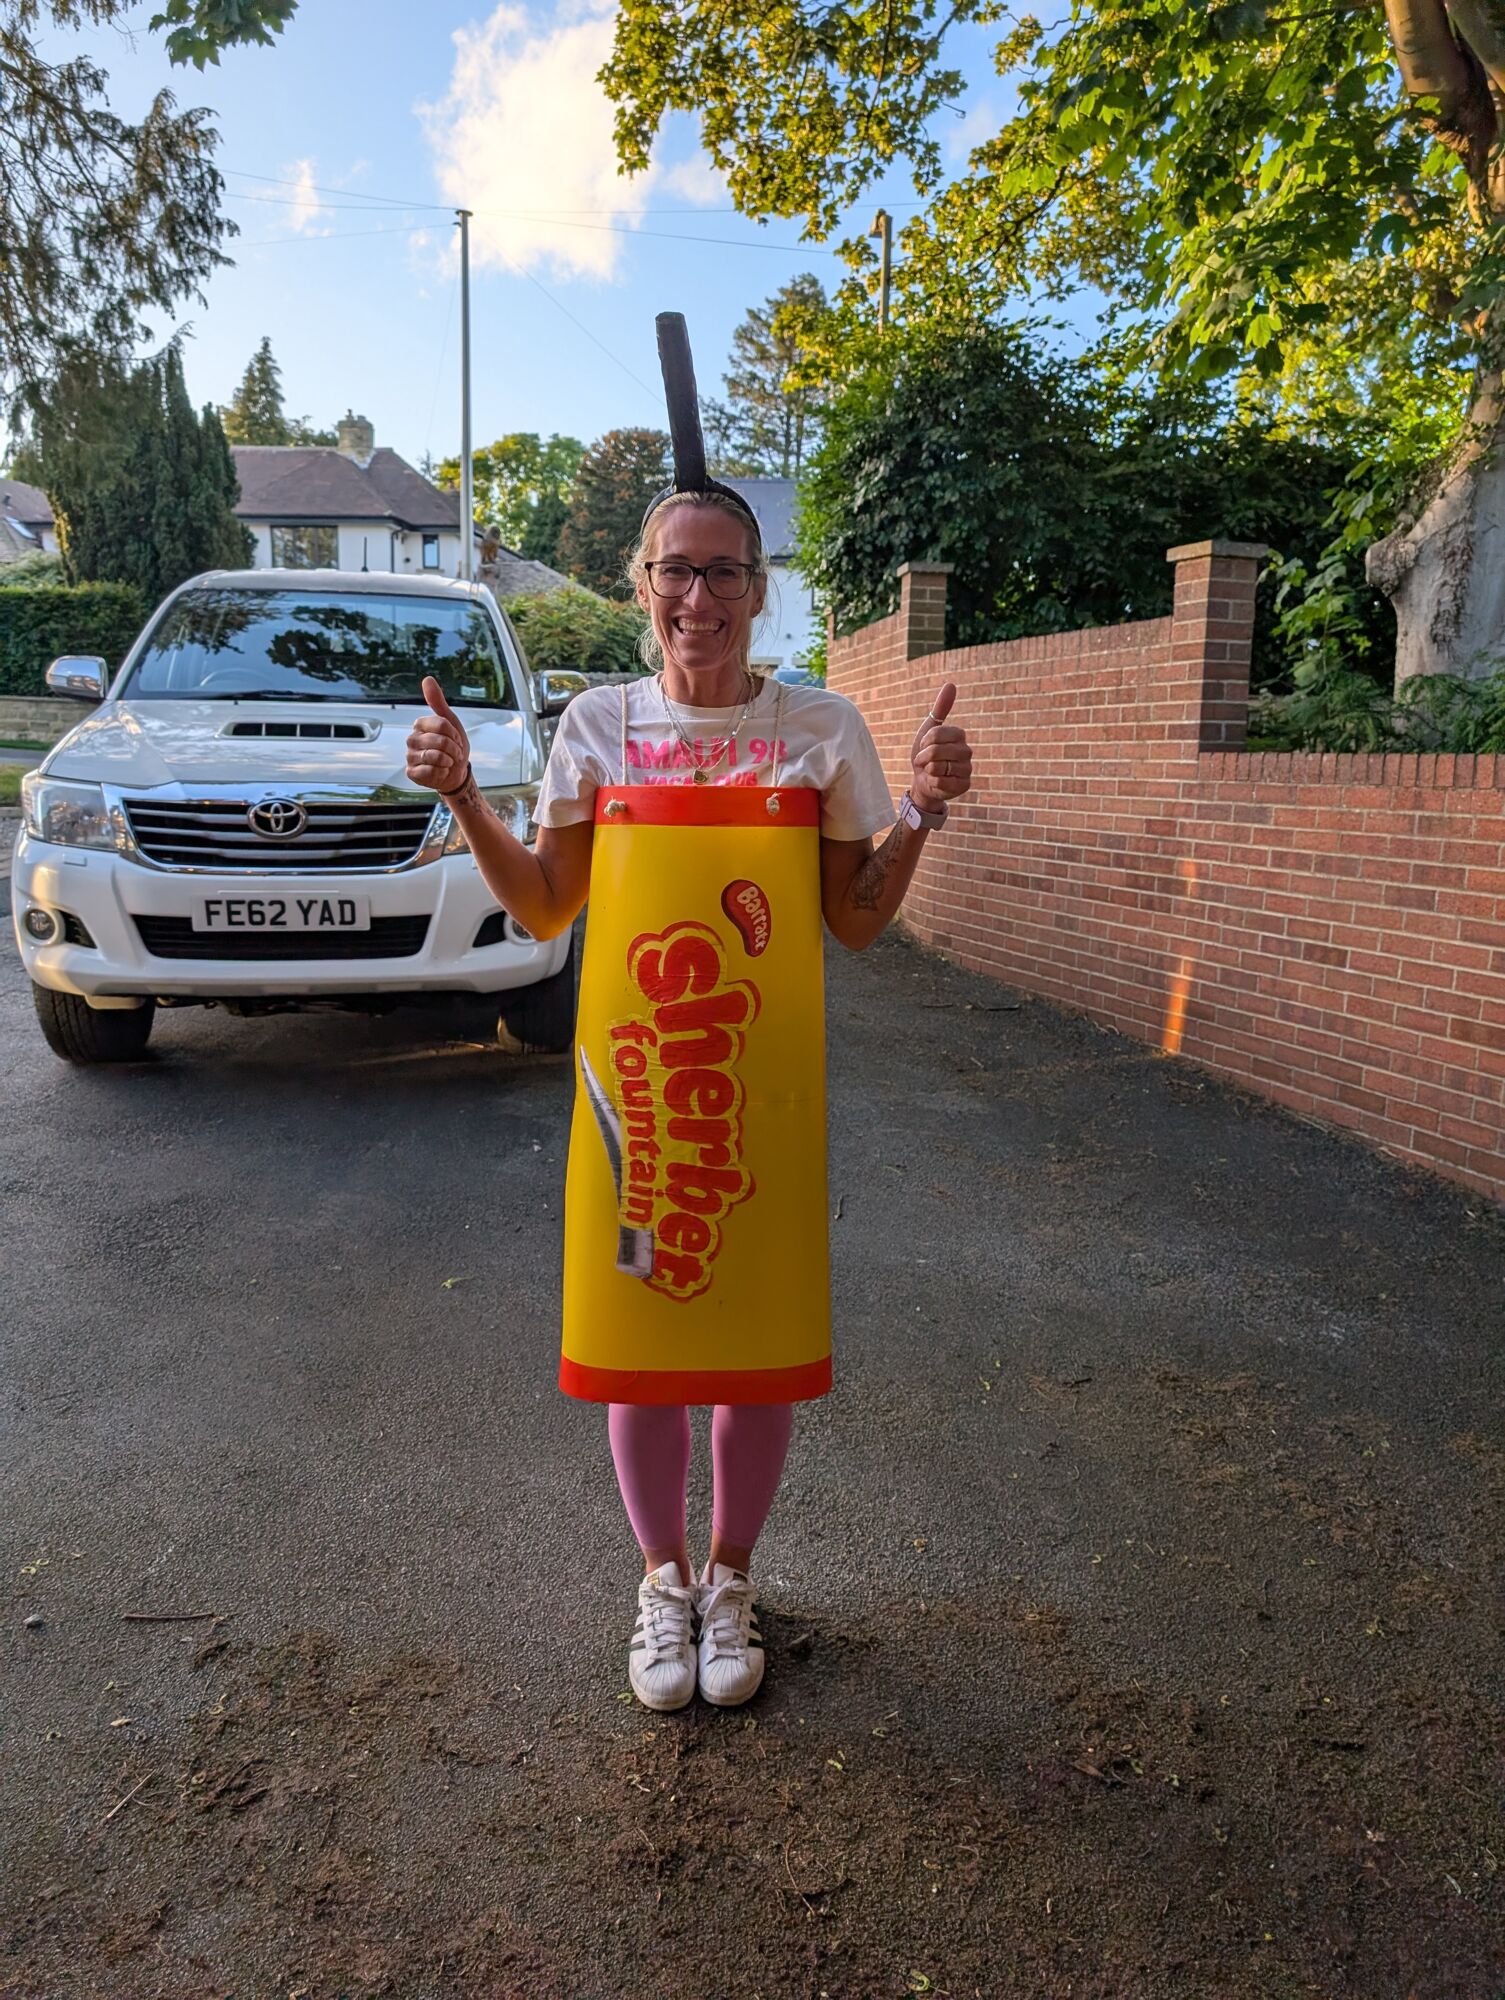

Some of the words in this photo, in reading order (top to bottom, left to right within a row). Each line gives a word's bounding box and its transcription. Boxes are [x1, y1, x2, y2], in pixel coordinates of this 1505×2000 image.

[748, 738, 788, 764] 98
[204, 899, 287, 926] FE62
[296, 899, 358, 926] YAD
[736, 886, 768, 951] Barratt
[610, 1020, 665, 1224] fountain
